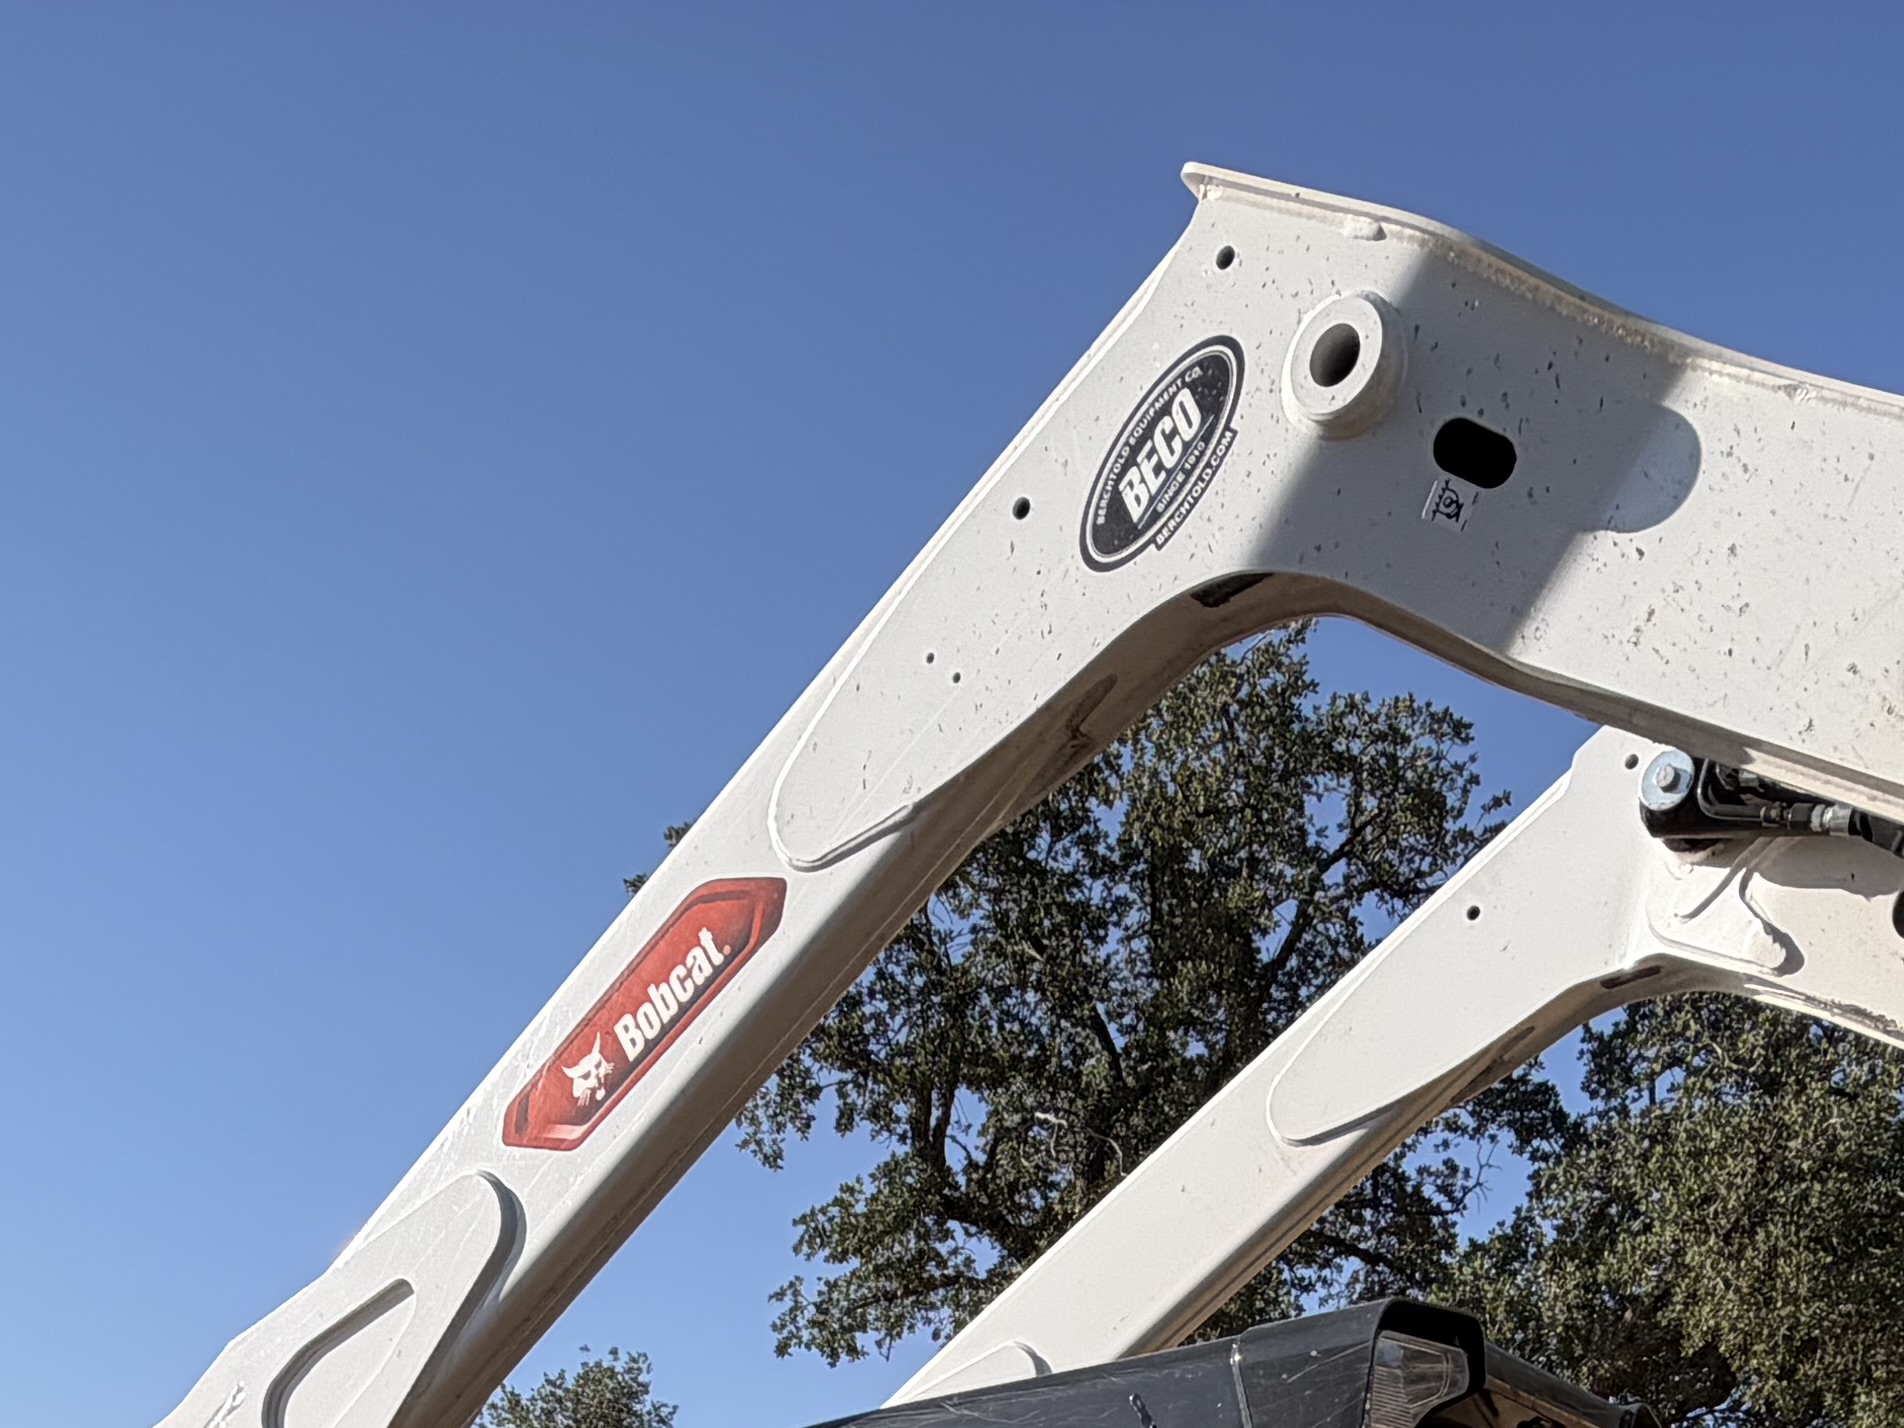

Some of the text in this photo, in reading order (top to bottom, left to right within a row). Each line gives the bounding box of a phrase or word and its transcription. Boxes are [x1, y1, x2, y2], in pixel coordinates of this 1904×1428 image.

[1096, 445, 1130, 525] BERCHTOLD
[1129, 379, 1183, 446] EQUIPMENT
[1118, 387, 1202, 524] BECO
[1156, 431, 1234, 546] BERCHTOLD.COM
[1156, 470, 1186, 513] SINCE
[613, 926, 724, 1063] Bobcat
